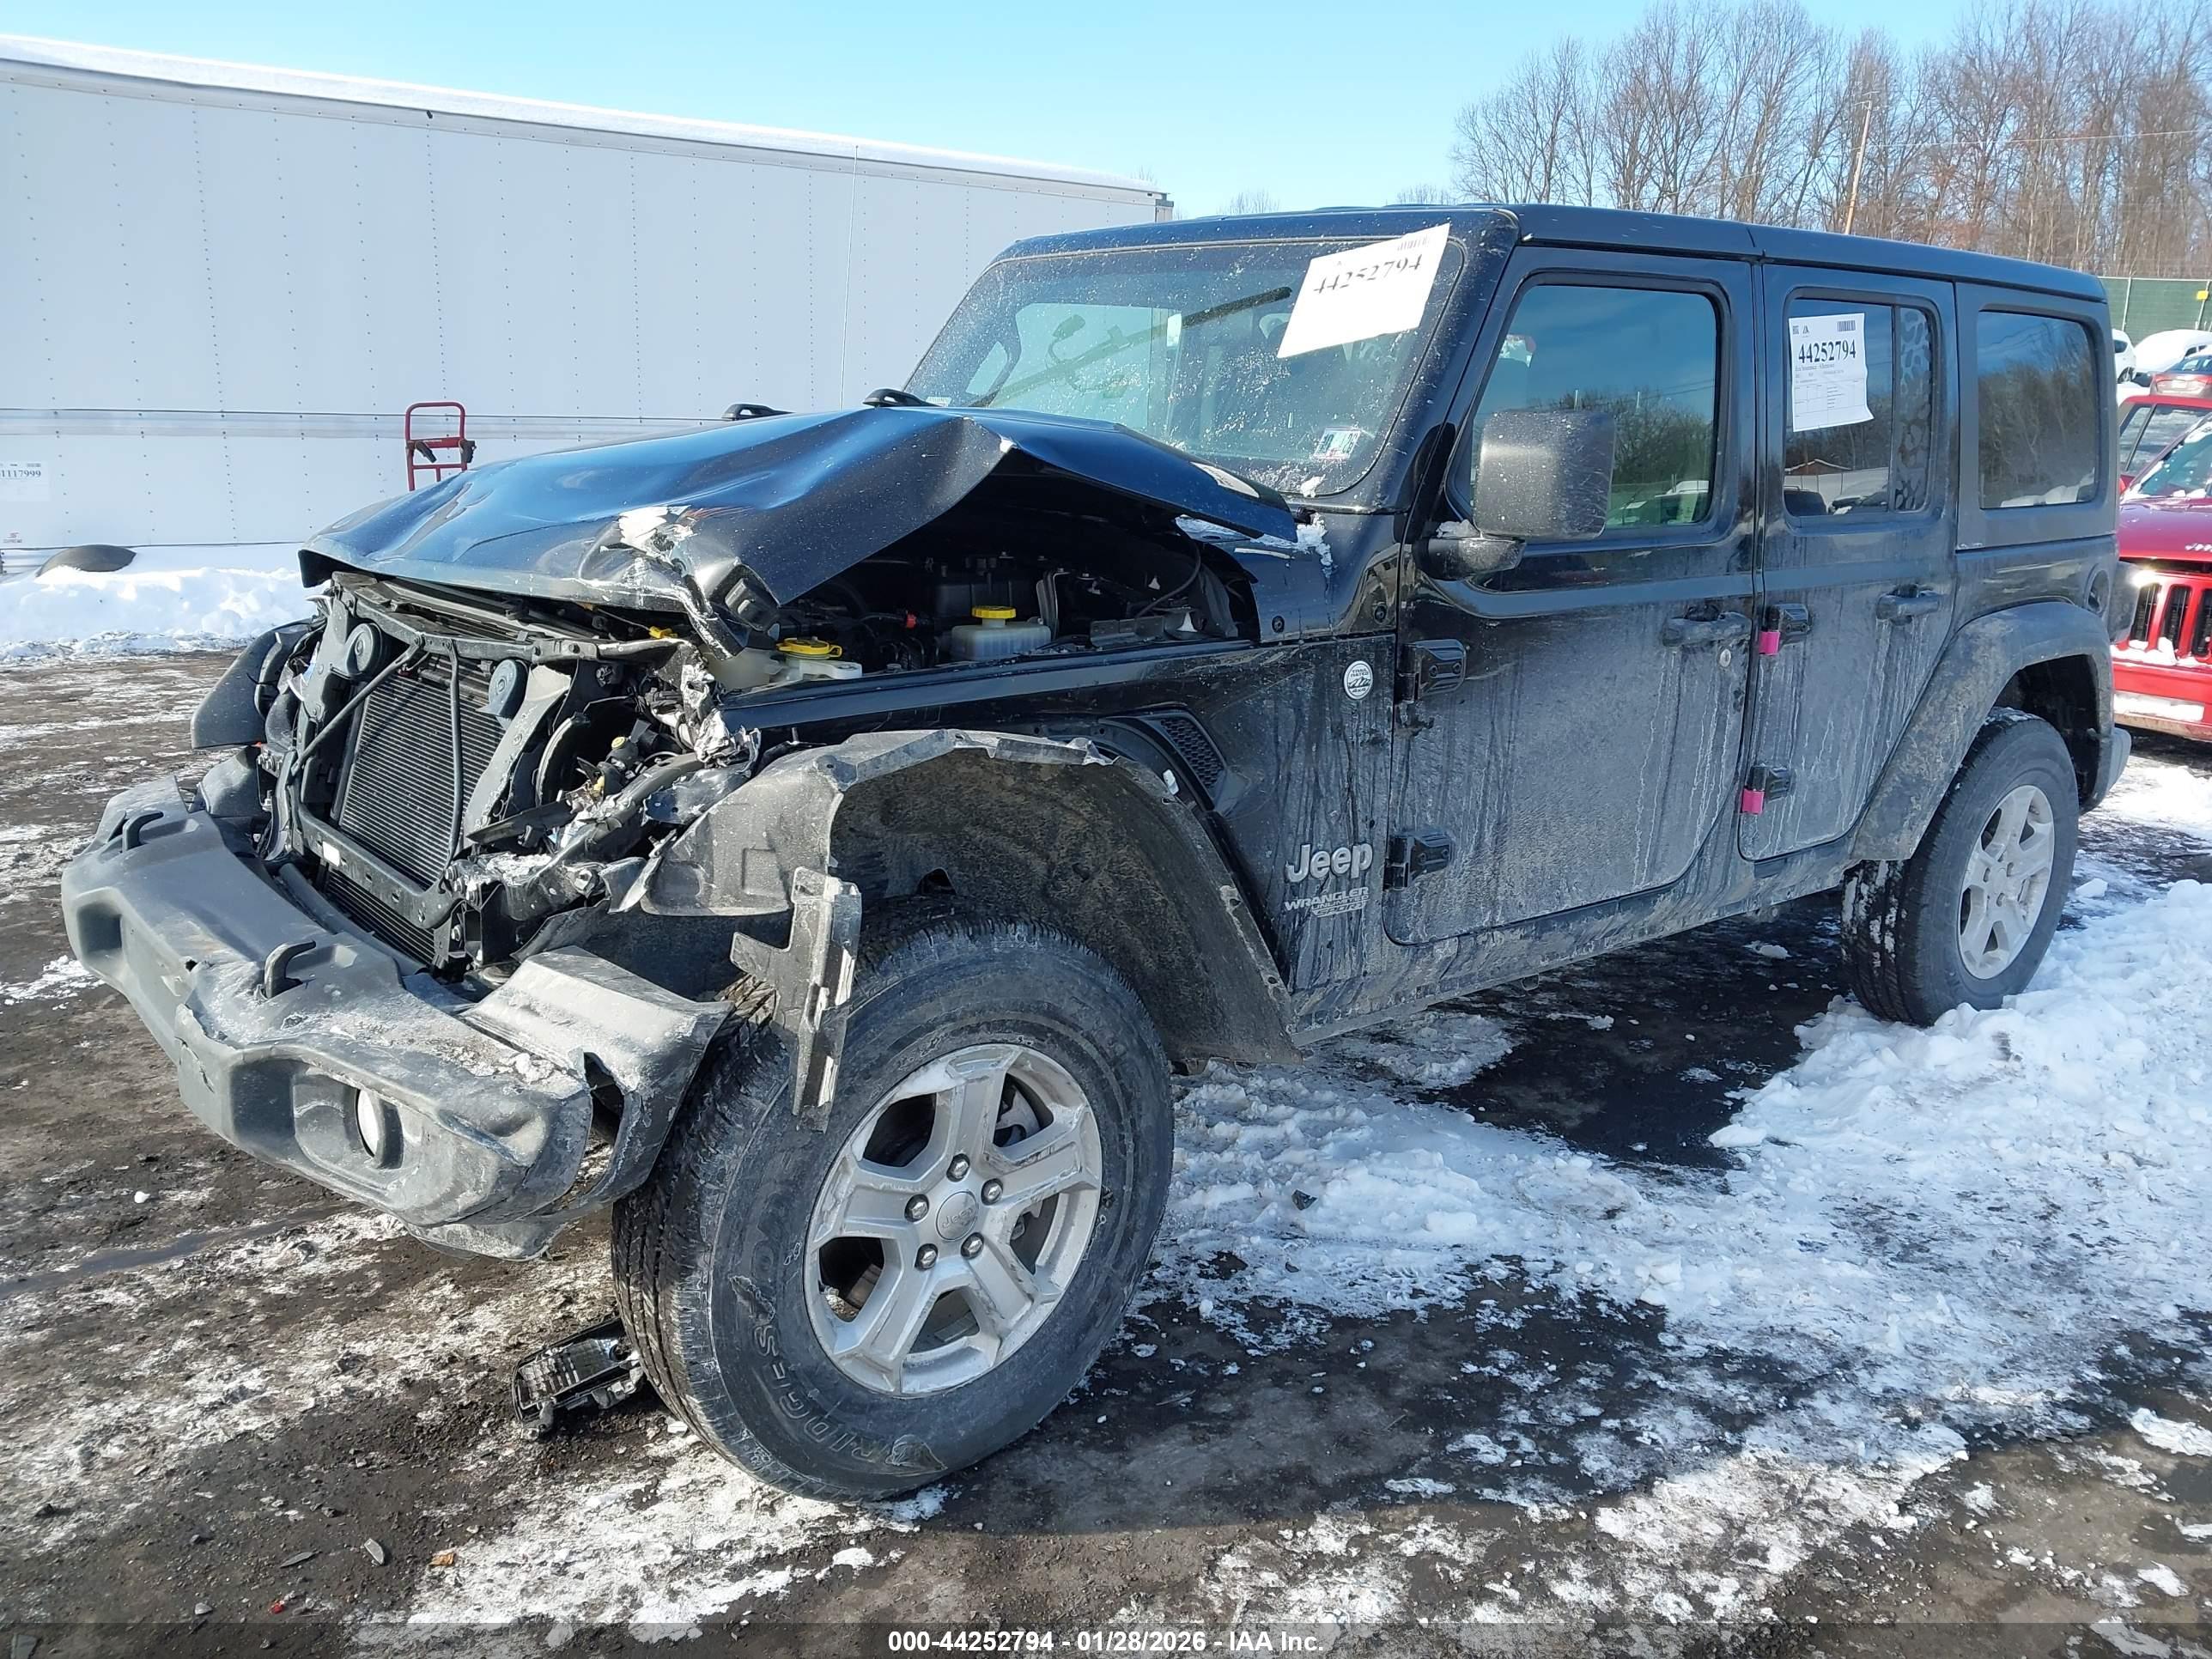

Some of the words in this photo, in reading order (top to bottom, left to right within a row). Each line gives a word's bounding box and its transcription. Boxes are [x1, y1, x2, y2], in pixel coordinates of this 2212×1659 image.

[1313, 254, 1422, 294] 44252794
[1798, 339, 1856, 363] 44252794
[1286, 843, 1373, 883] Jeep
[1285, 887, 1369, 911] WRANGLER
[1312, 896, 1369, 910] UNLIMITED
